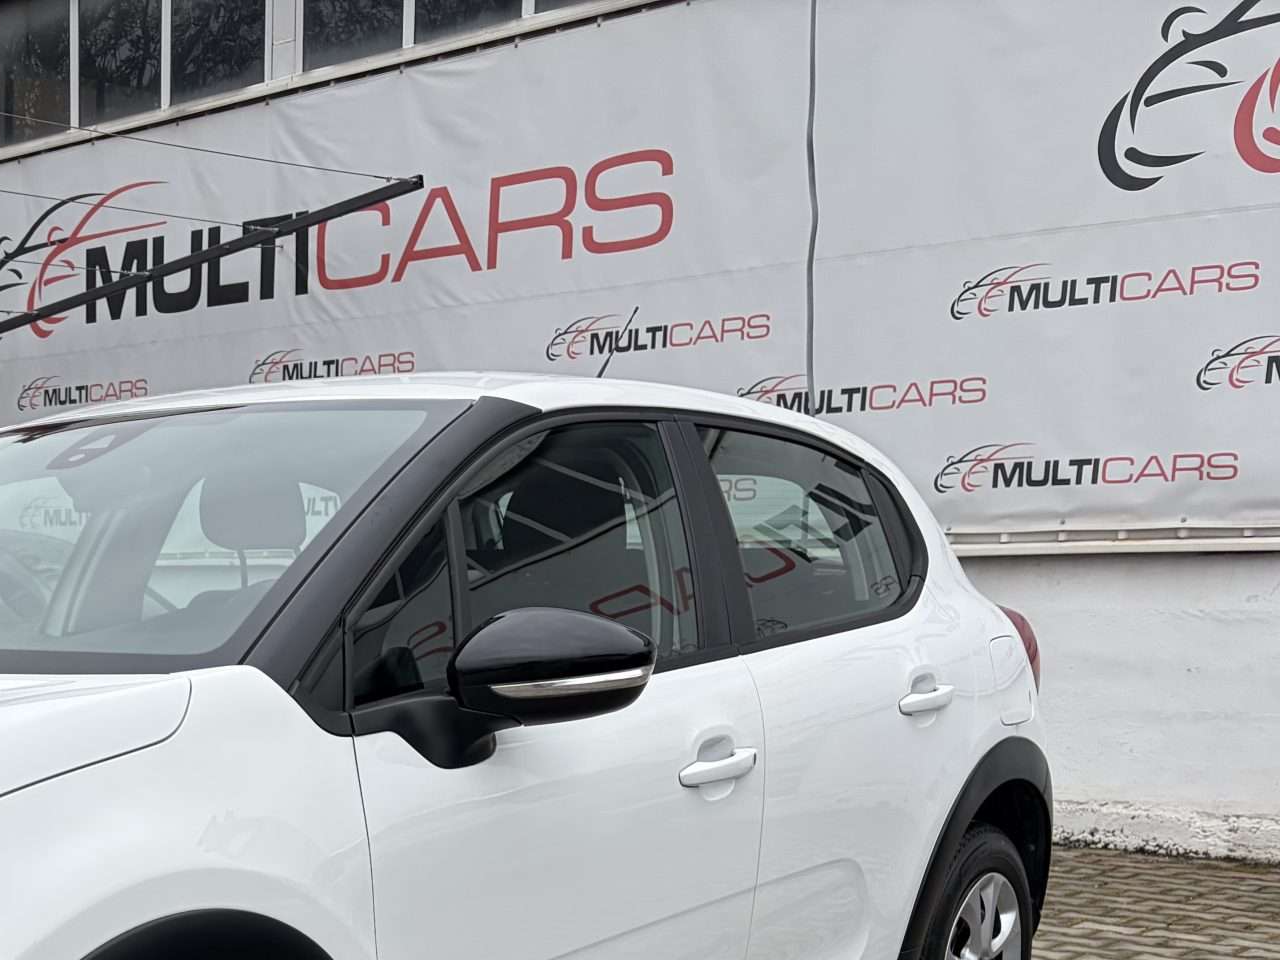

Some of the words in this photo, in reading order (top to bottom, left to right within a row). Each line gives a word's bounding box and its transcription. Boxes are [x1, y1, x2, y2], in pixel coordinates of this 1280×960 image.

[85, 148, 674, 324] MULTICARS
[1007, 261, 1261, 313] MULTICARS
[589, 313, 770, 356] MULTICARS
[282, 351, 415, 381] MULTICARS
[43, 378, 148, 407] MULTICARS
[776, 377, 987, 415] MULTICARS
[992, 452, 1239, 489] MULTICARS
